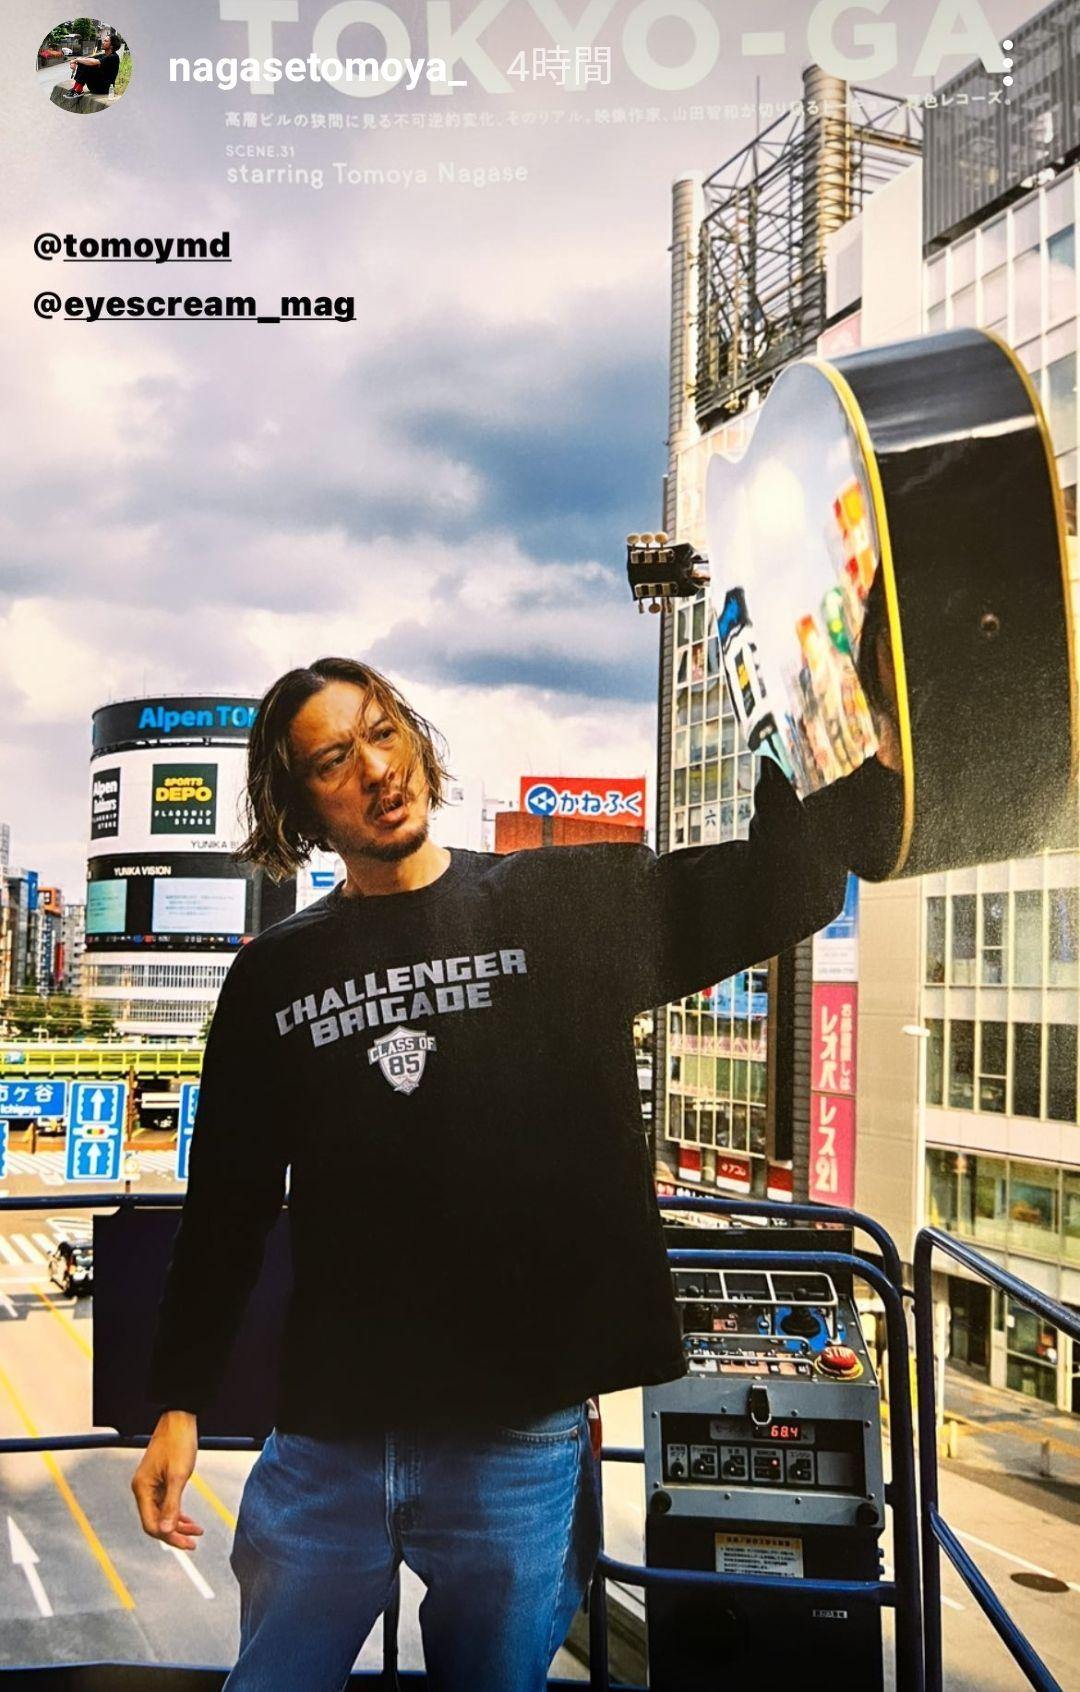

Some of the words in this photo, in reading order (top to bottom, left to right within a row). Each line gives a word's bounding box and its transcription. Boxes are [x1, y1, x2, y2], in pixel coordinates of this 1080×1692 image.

[138, 706, 213, 732] Alpen
[155, 786, 212, 802] DEPO
[559, 791, 642, 815] かねふく
[141, 865, 172, 876] VISION
[275, 949, 528, 1036] CHALLENGER
[310, 982, 493, 1048] BRIGADE
[371, 1038, 415, 1063] CLASS
[418, 1036, 436, 1051] OF
[388, 1053, 420, 1076] 85
